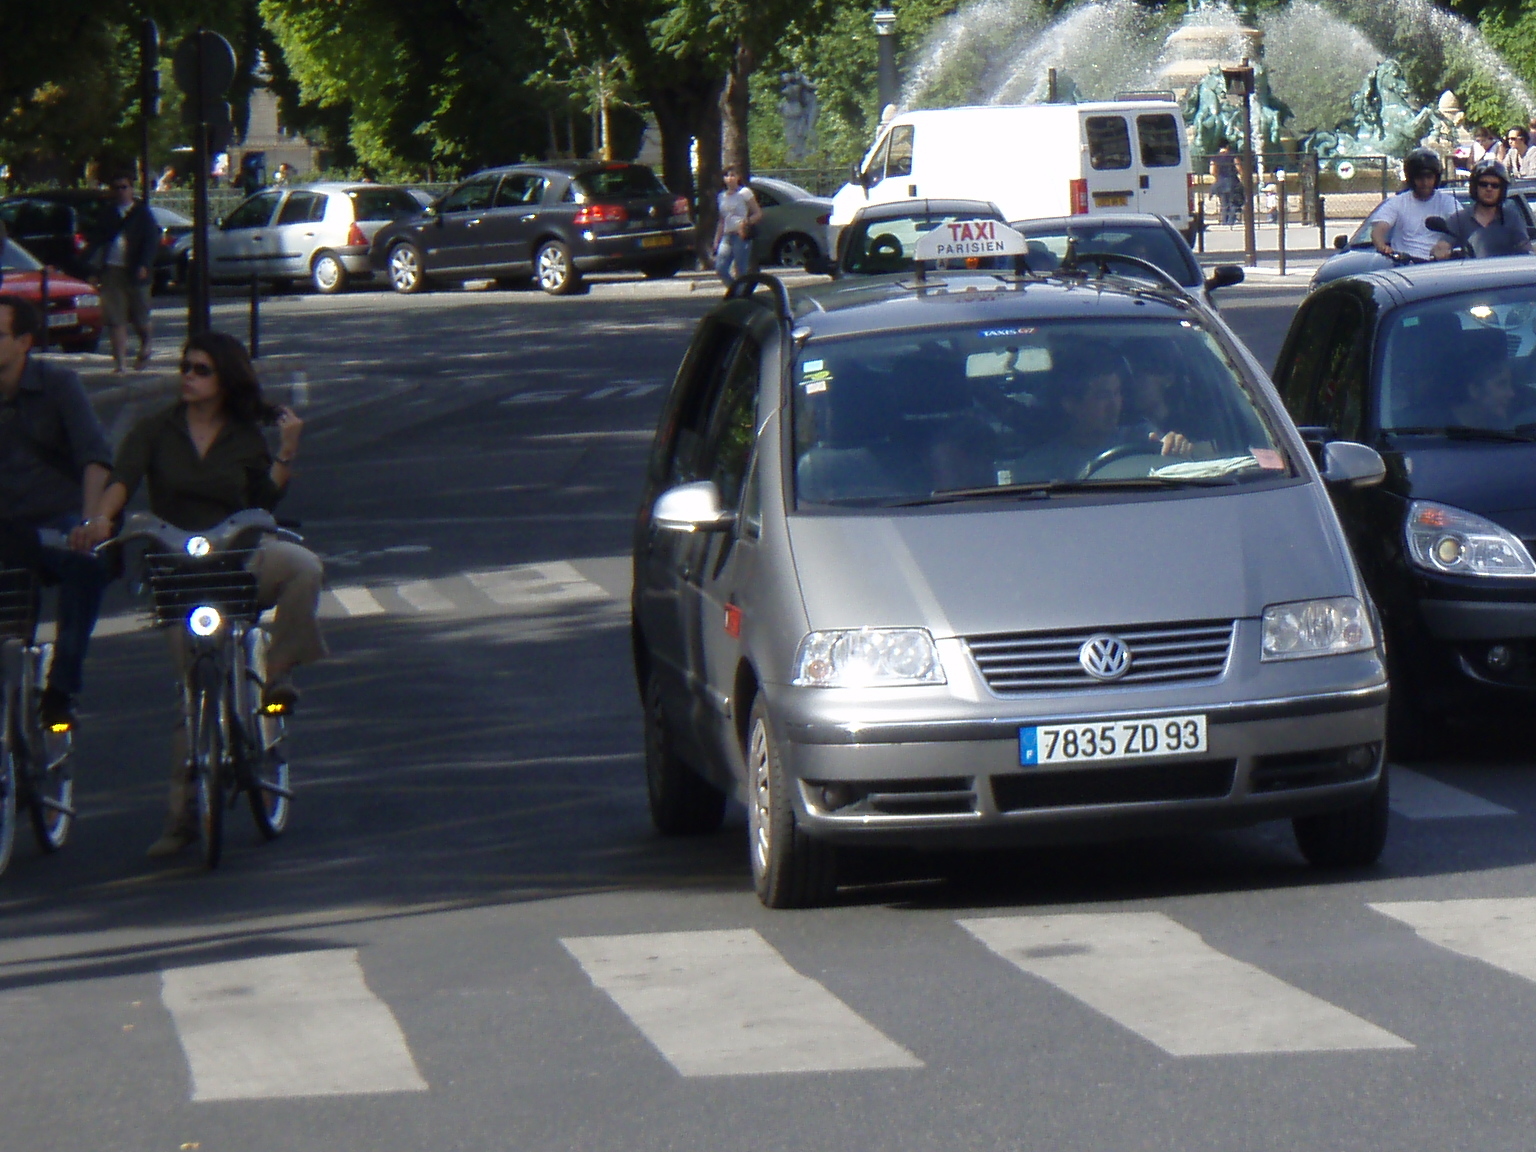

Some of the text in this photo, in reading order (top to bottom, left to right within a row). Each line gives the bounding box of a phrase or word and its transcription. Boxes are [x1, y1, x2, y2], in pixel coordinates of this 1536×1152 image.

[948, 222, 995, 241] TAXI
[937, 241, 1004, 254] PARISIEN
[1043, 726, 1116, 760] 7835
[1122, 724, 1158, 754] ZD
[1165, 720, 1200, 751] 93
